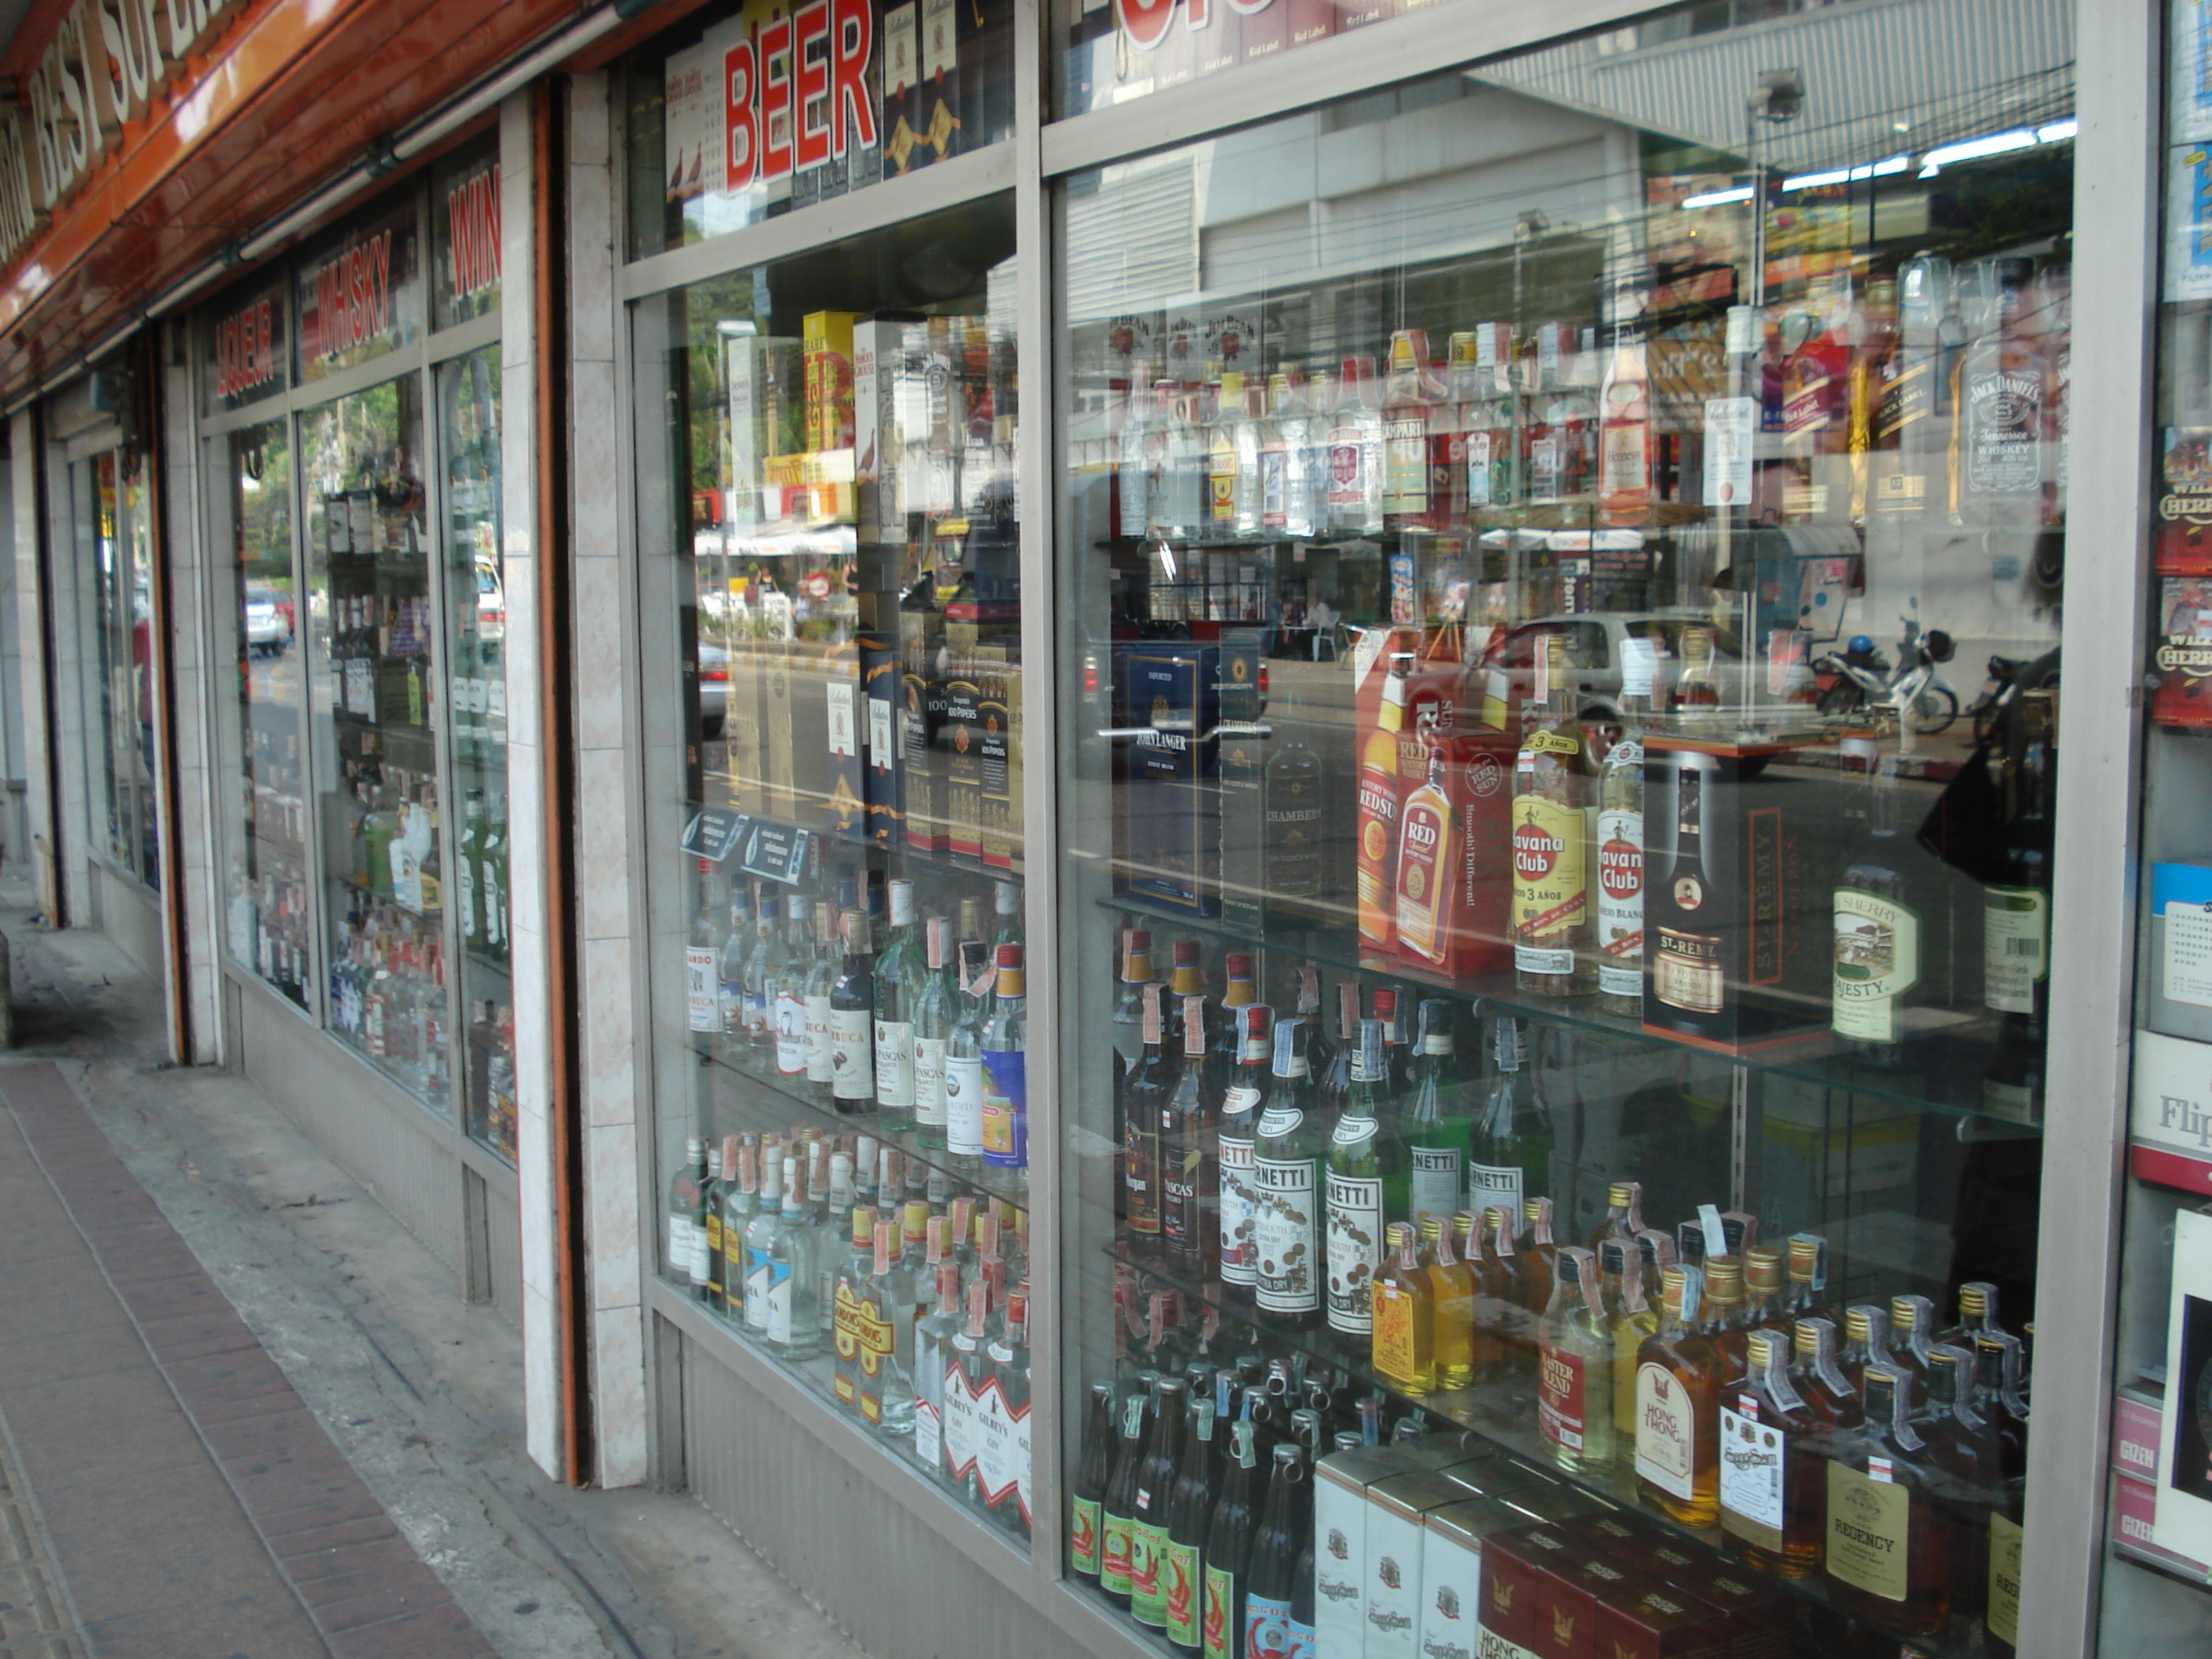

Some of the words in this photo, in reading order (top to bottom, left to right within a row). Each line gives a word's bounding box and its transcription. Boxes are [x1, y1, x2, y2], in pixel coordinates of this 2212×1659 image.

[29, 0, 103, 211] BEST
[724, 0, 877, 198] BEER
[449, 163, 502, 300] WIN
[317, 228, 391, 358] WHISKY
[804, 336, 824, 353] RARE
[1970, 378, 1995, 404] JACK
[1995, 374, 2041, 402] DANIEL'S
[1382, 420, 1423, 440] AMPARI
[1977, 444, 2031, 455] WHISKEY
[2159, 494, 2212, 521] CHERR
[2156, 645, 2212, 672] CHERR
[928, 700, 948, 712] 100
[948, 707, 957, 718] 100
[957, 706, 977, 719] PIPERS
[1136, 729, 1156, 747] JOHN
[1156, 732, 1187, 751] LANGER
[1400, 741, 1429, 760] RED
[1535, 736, 1545, 749] 3
[989, 746, 1006, 757] PIPERS
[1402, 768, 1426, 780] WHISKY
[1471, 764, 1496, 786] RED
[1476, 775, 1499, 794] SUN
[1407, 822, 1437, 845] RED
[1466, 804, 1475, 850] Smooth!
[1515, 854, 1548, 873] Club
[1599, 850, 1642, 868] avan
[1466, 852, 1475, 907] Different!
[1602, 868, 1640, 890] Club
[1527, 888, 1535, 901] 3
[1537, 890, 1562, 901] AÑOS
[1843, 896, 1901, 923] SHERRY
[878, 1048, 907, 1061] PASCAS
[916, 1066, 945, 1079] PASCAS
[1413, 1154, 1454, 1169] NETTI
[1274, 1277, 1290, 1291] DRY
[945, 1391, 972, 1416] GILBEY'S
[951, 1415, 963, 1429] GIN
[979, 1411, 1009, 1439] GILBEY'S
[1646, 1402, 1678, 1429] HONG
[1643, 1413, 1681, 1444] THONG
[986, 1436, 999, 1452] GIN
[2119, 1439, 2154, 1469] GIZEH
[1834, 1517, 1895, 1553] REGENCY
[1481, 1629, 1520, 1657] HONG
